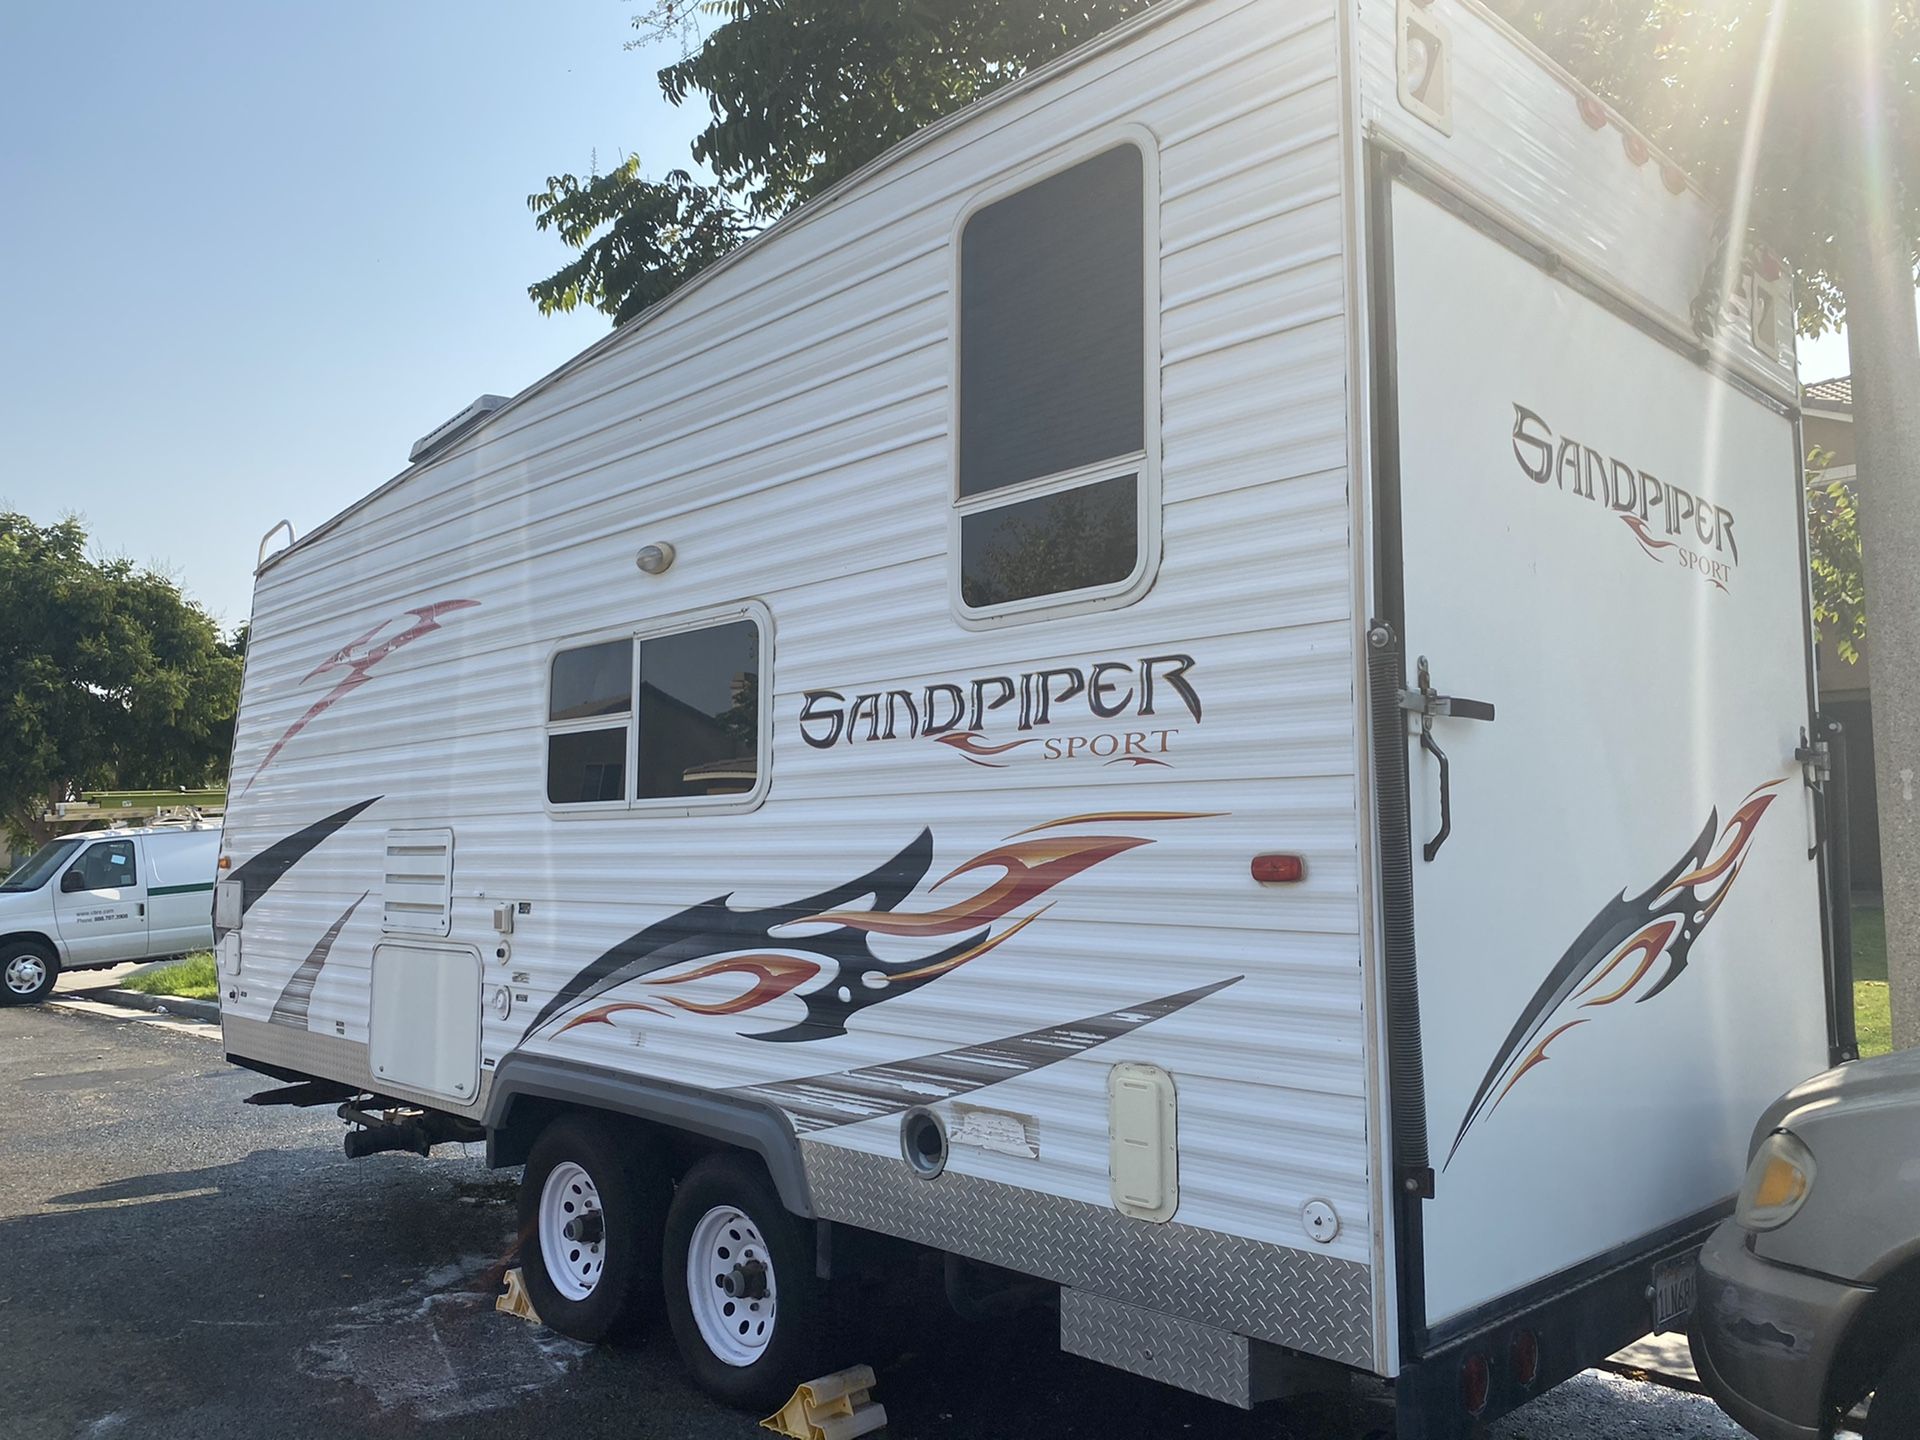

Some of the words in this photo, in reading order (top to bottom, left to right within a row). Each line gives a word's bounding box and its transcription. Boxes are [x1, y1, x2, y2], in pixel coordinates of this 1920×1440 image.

[1512, 401, 1738, 567] SANDPIPER
[1678, 547, 1731, 583] SPORT
[800, 653, 1202, 750] SANDPIPER
[1043, 728, 1180, 761] SPORT
